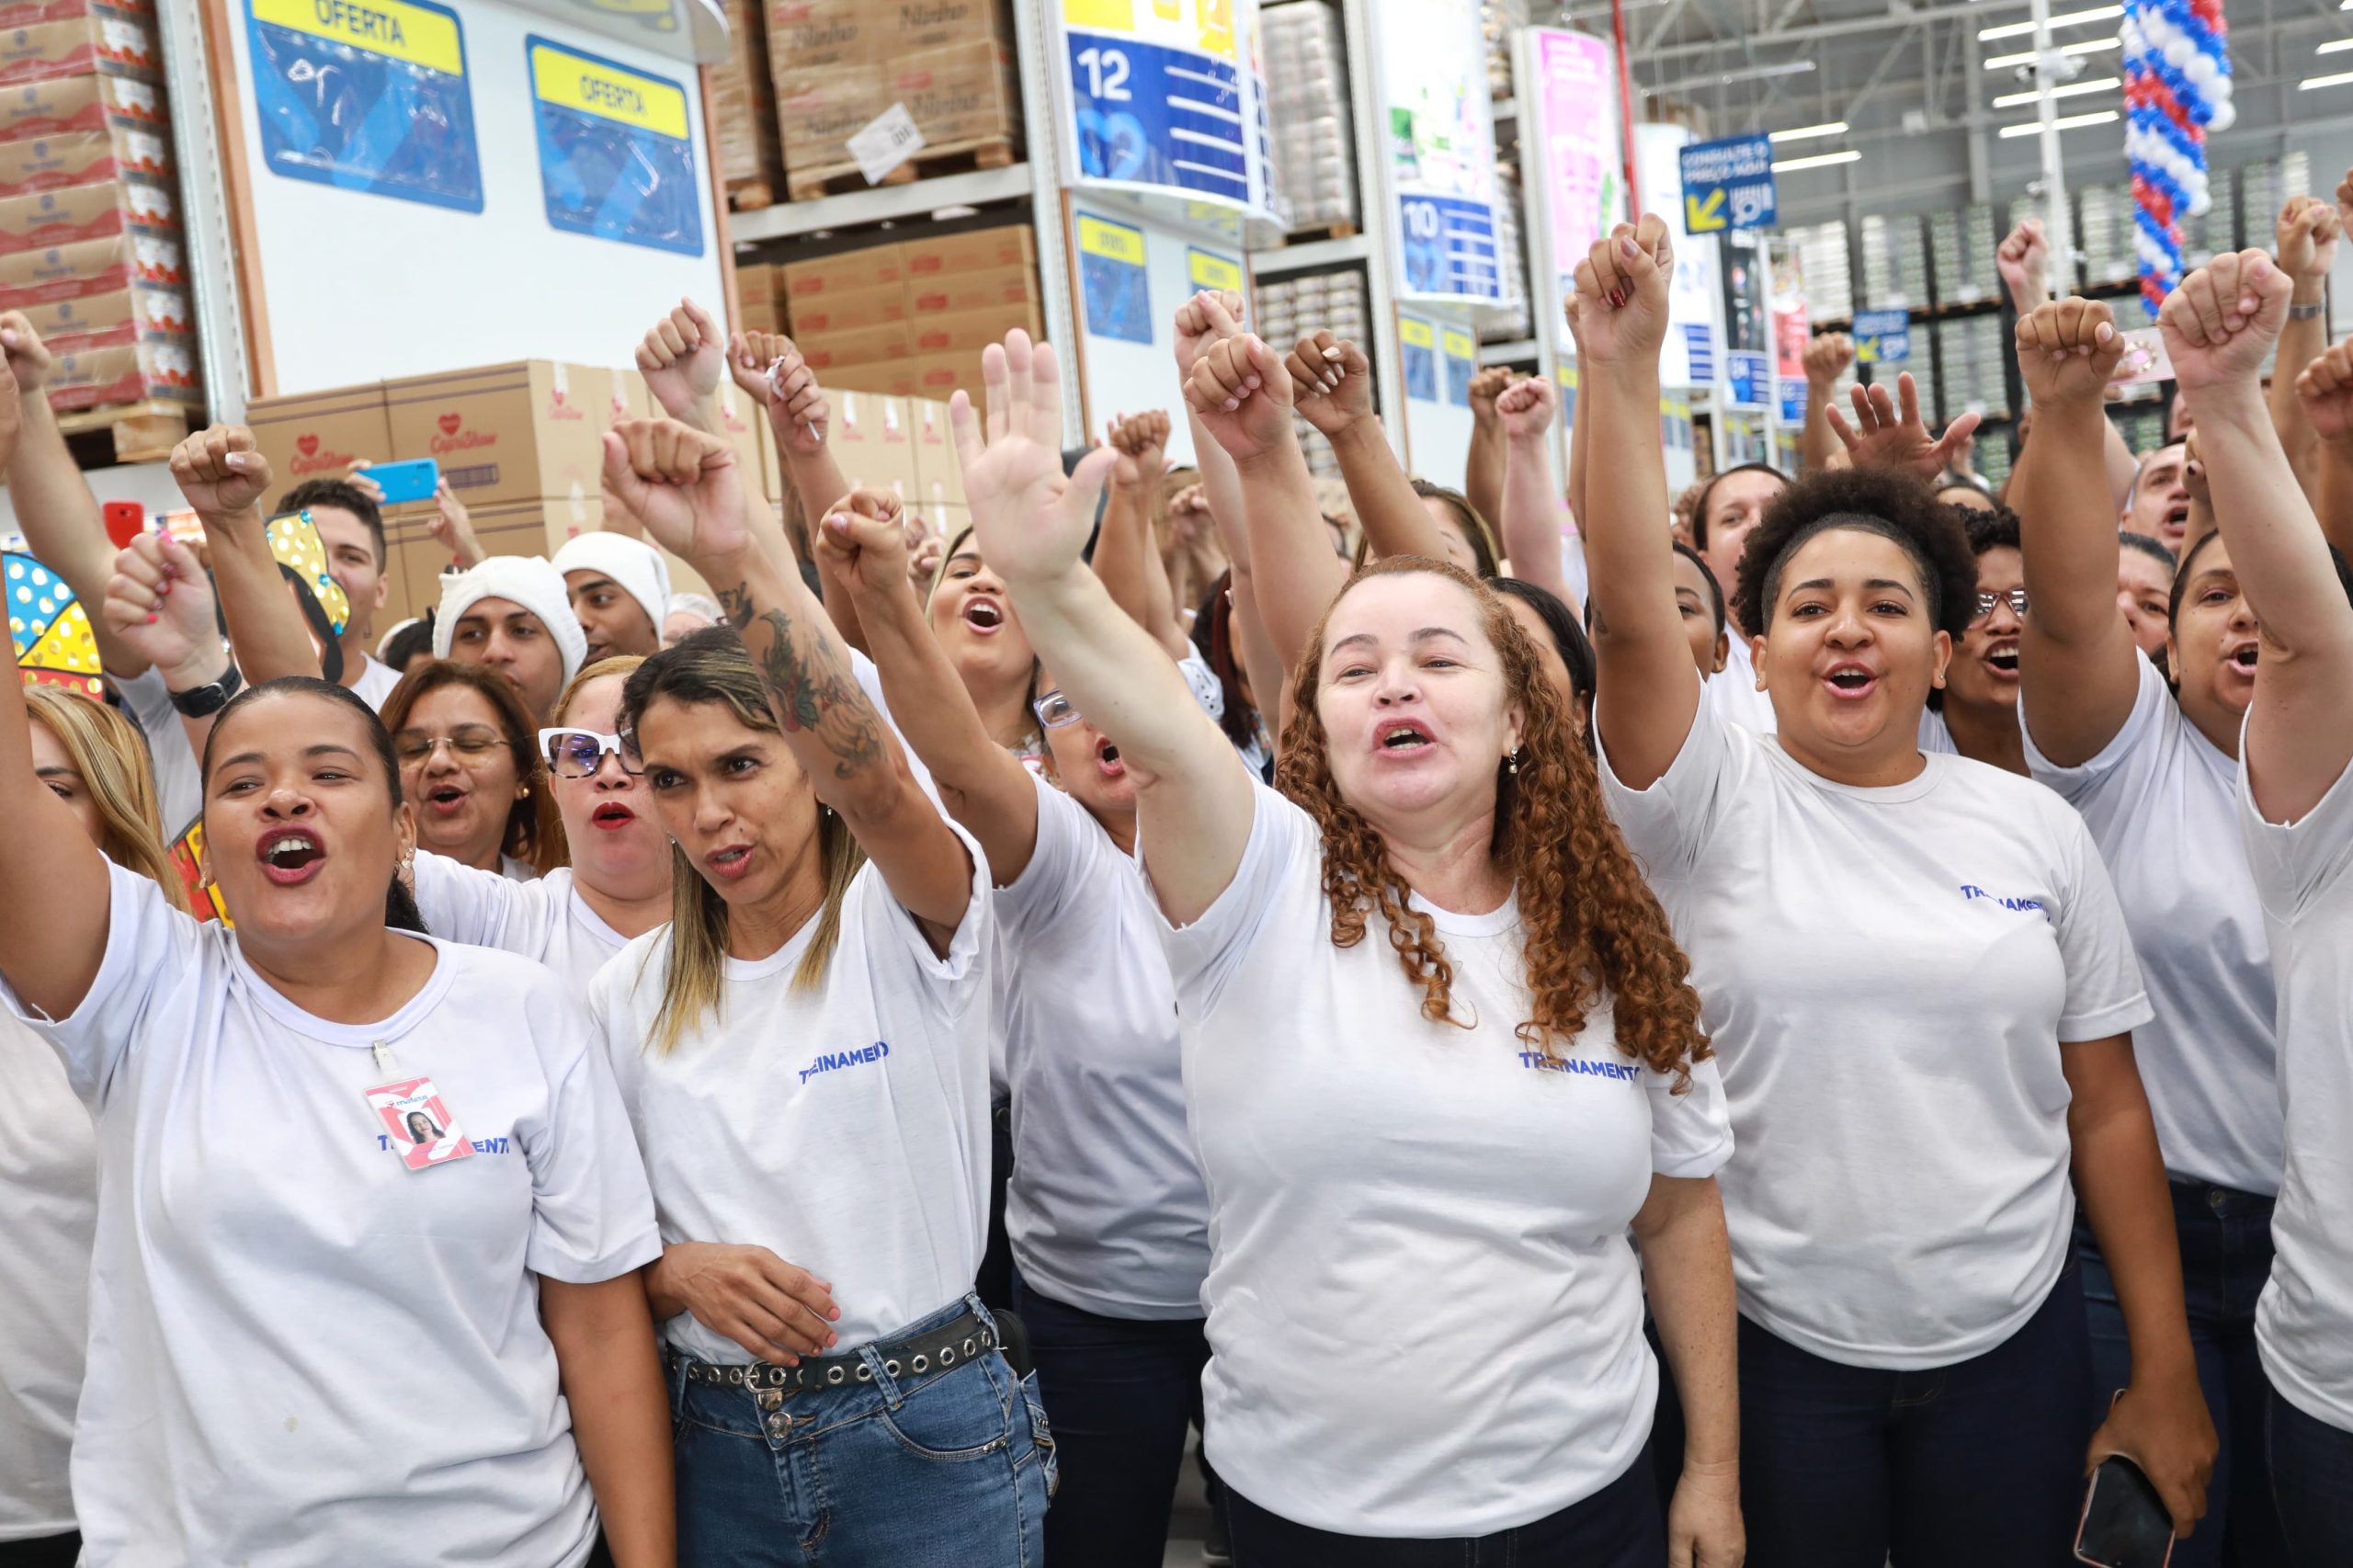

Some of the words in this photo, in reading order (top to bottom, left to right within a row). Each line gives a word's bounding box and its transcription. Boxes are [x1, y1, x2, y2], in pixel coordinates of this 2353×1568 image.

[314, 0, 407, 49] OFERTA
[579, 74, 649, 118] OFERTA
[1076, 47, 1133, 102] 12
[1403, 200, 1439, 238] 10
[798, 1040, 890, 1085] TINAME
